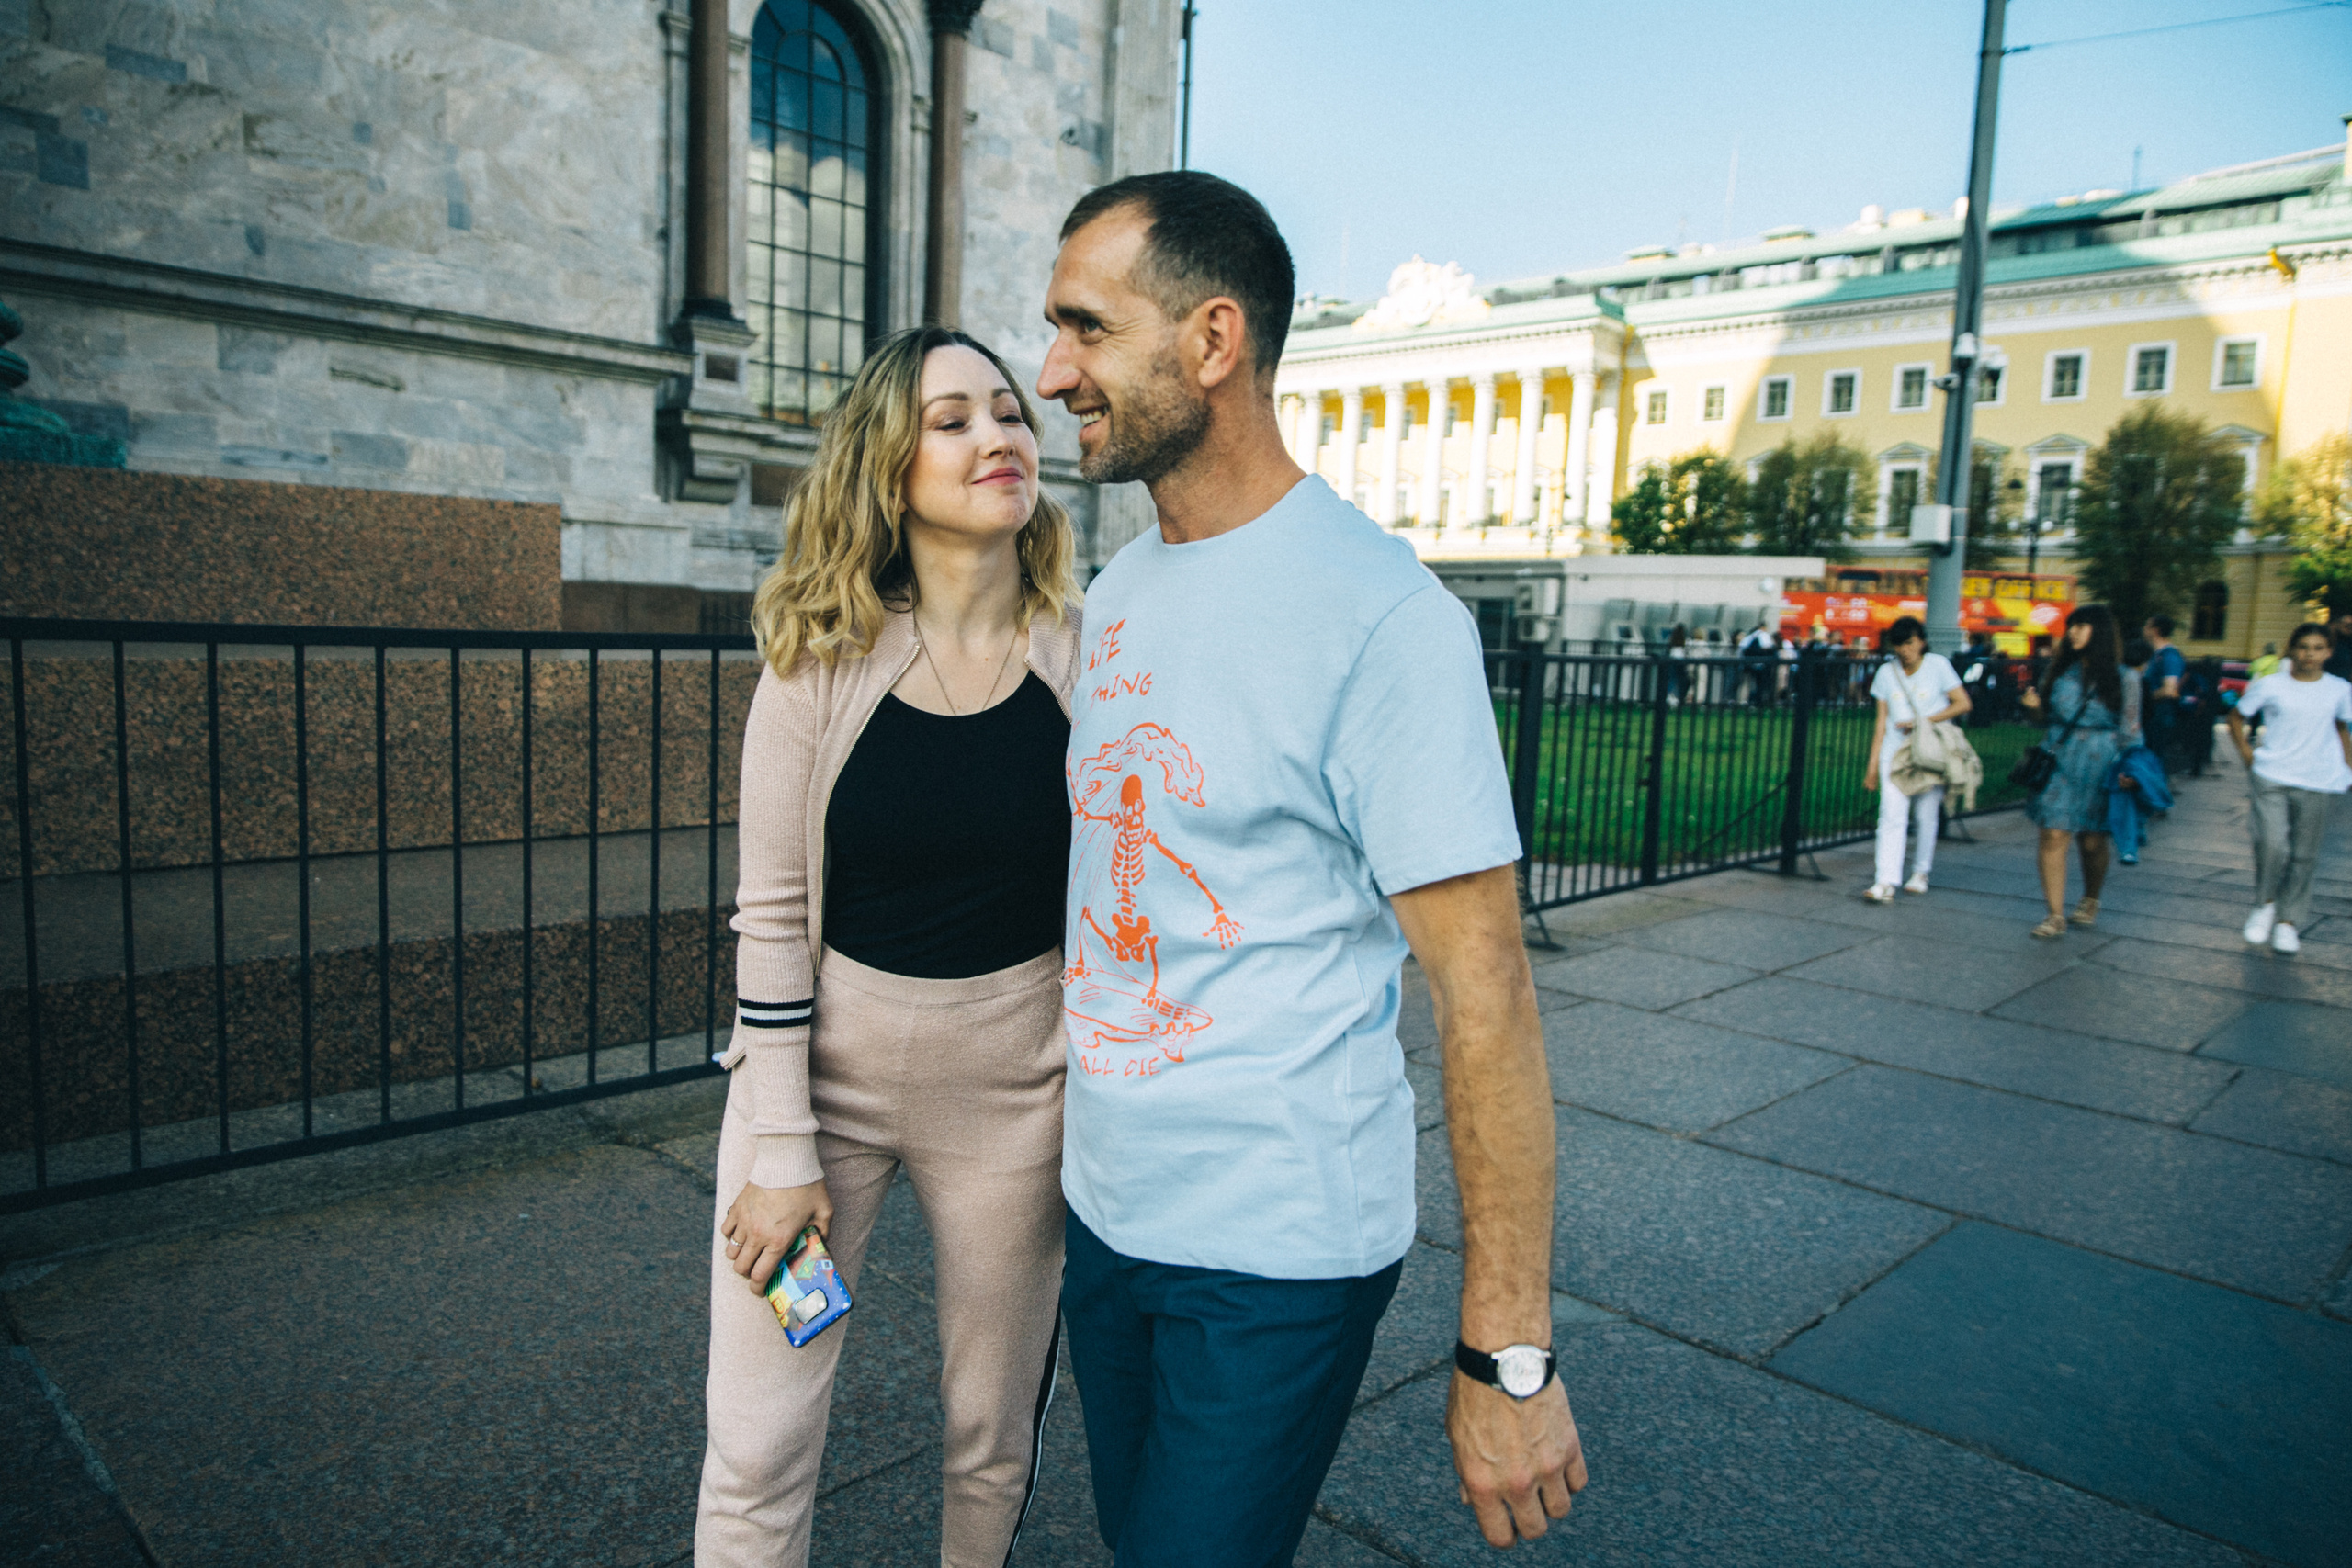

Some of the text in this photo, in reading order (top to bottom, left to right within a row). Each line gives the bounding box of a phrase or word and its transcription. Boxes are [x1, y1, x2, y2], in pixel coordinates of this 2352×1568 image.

[1088, 618, 1126, 671] IFE
[1080, 1055, 1161, 1077] ALL DIE
